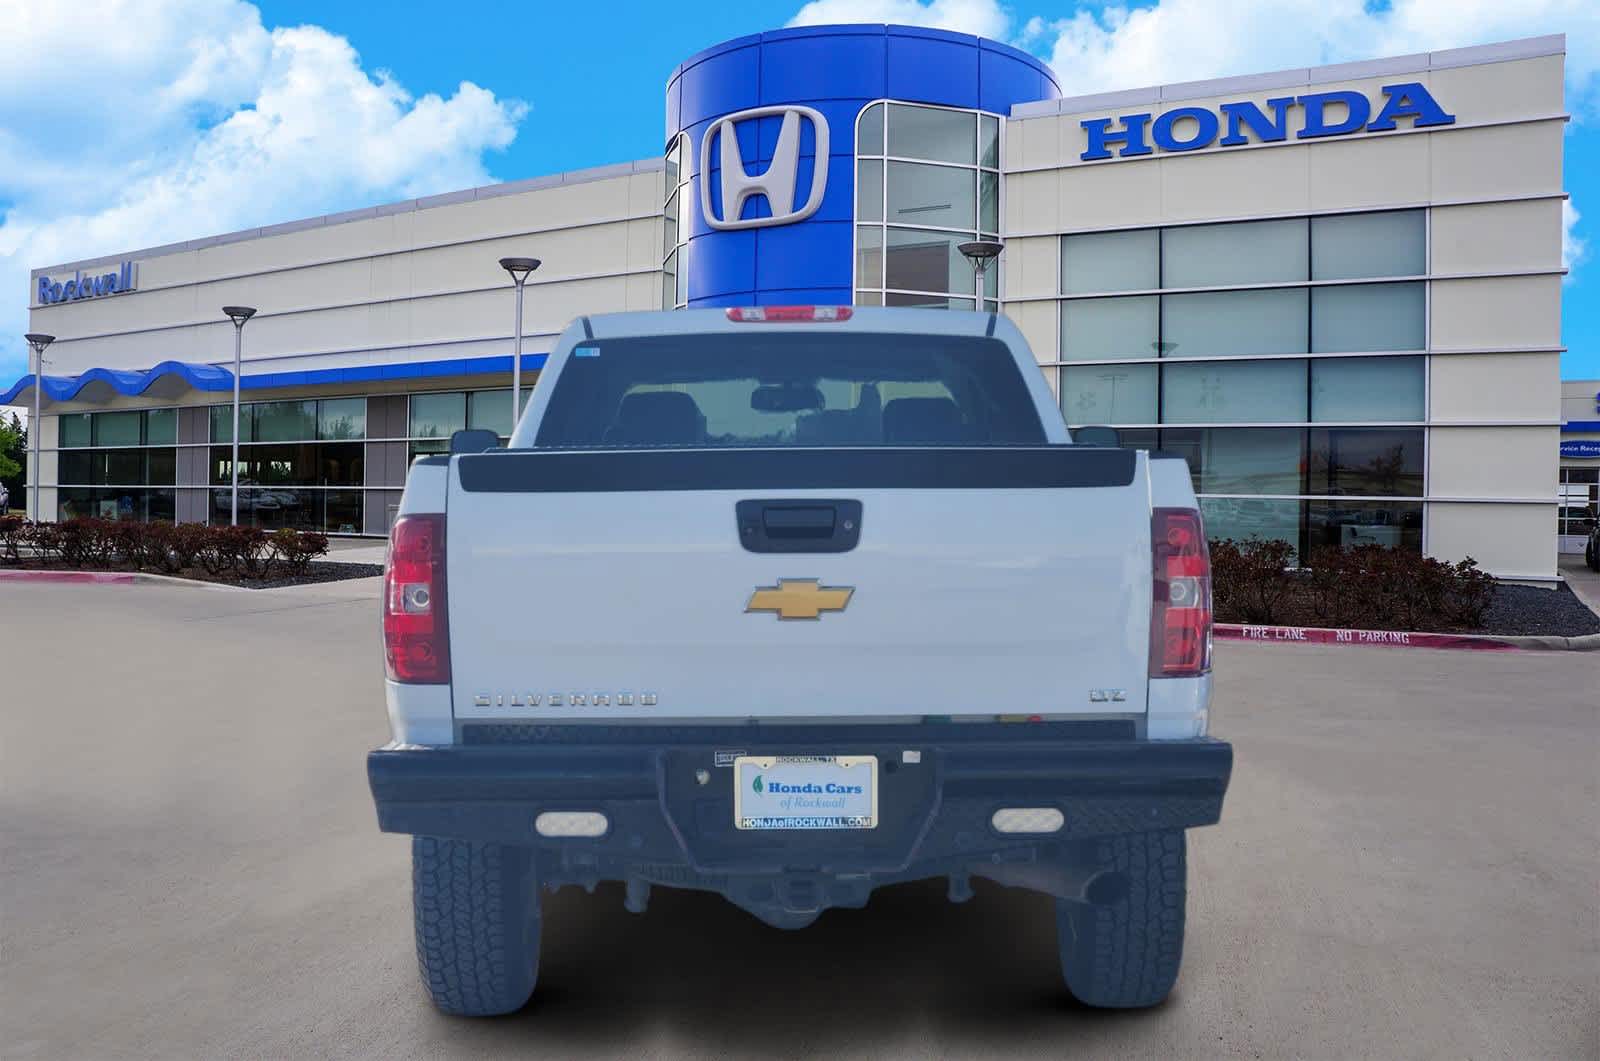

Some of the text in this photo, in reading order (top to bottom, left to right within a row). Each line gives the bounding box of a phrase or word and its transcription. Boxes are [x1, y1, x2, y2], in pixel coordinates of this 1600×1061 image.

[1080, 82, 1456, 161] HONDA
[38, 261, 134, 304] Rockwall
[1242, 626, 1307, 640] FIRE LANE
[1336, 629, 1409, 644] NO PARKING
[474, 693, 658, 707] SILVERADO
[768, 782, 863, 794] Honda Cars
[779, 796, 847, 810] of Rockwall
